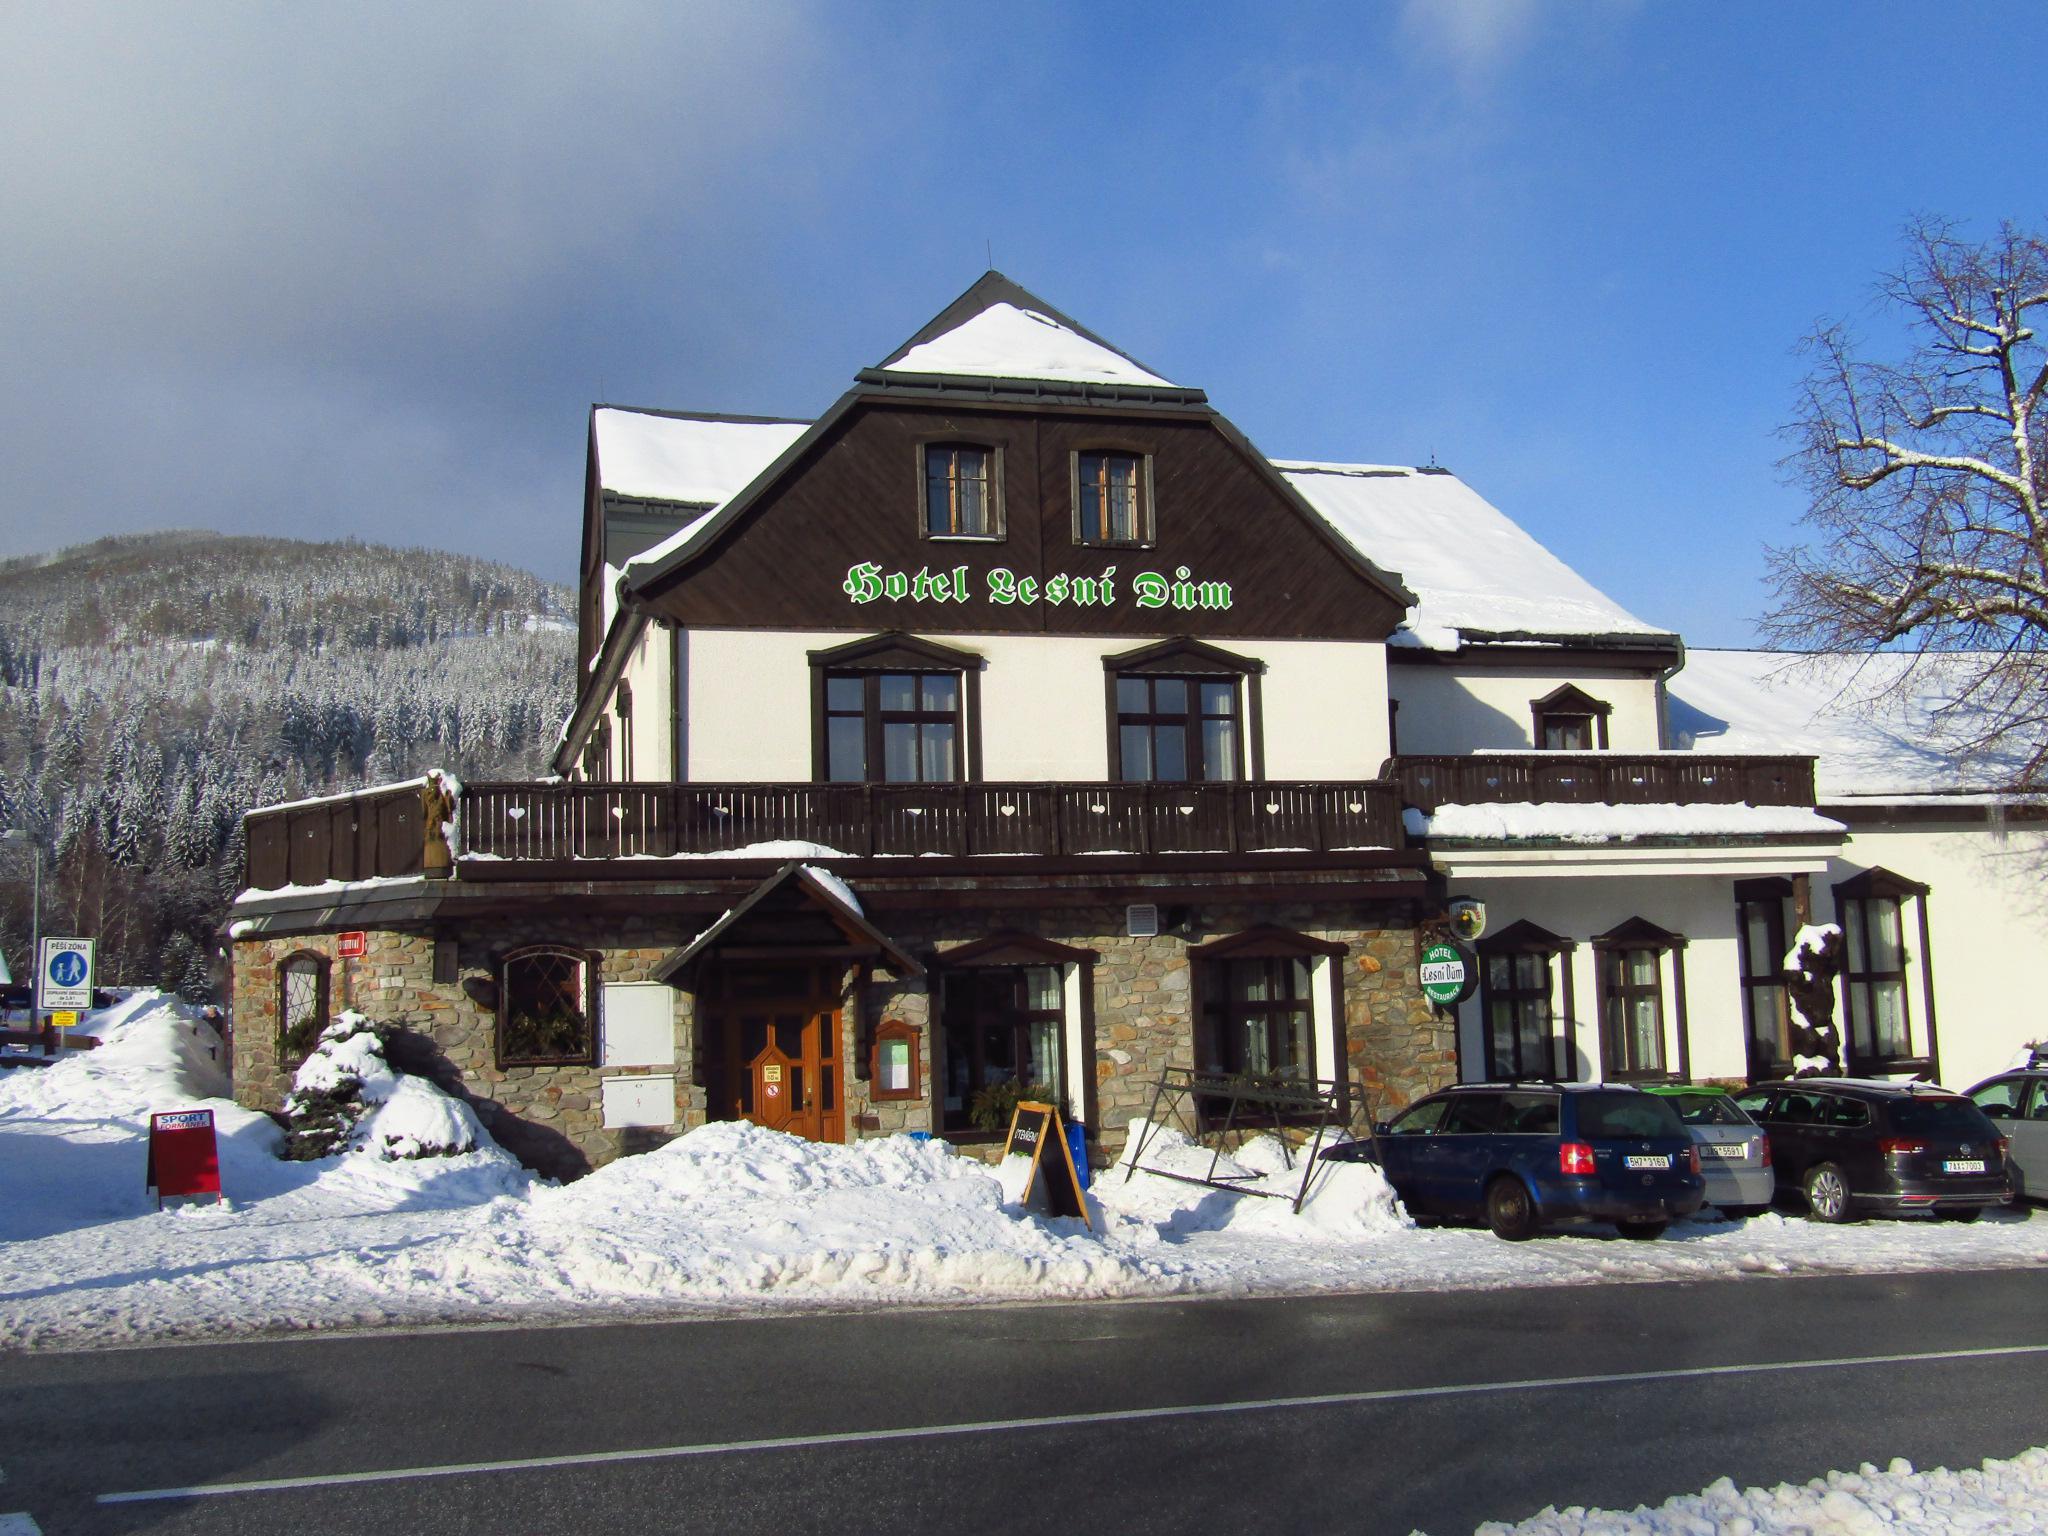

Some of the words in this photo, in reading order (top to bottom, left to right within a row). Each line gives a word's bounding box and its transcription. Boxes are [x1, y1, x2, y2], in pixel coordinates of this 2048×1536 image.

[842, 561, 971, 605] Hotel
[986, 565, 1117, 607] Lesní
[1132, 565, 1233, 611] Dům
[1428, 947, 1452, 961] HOTEL
[1423, 966, 1445, 981] Lesní
[1446, 964, 1463, 980] Dům
[1426, 984, 1461, 1002] RESTAURACE
[161, 1114, 205, 1124] SPORT
